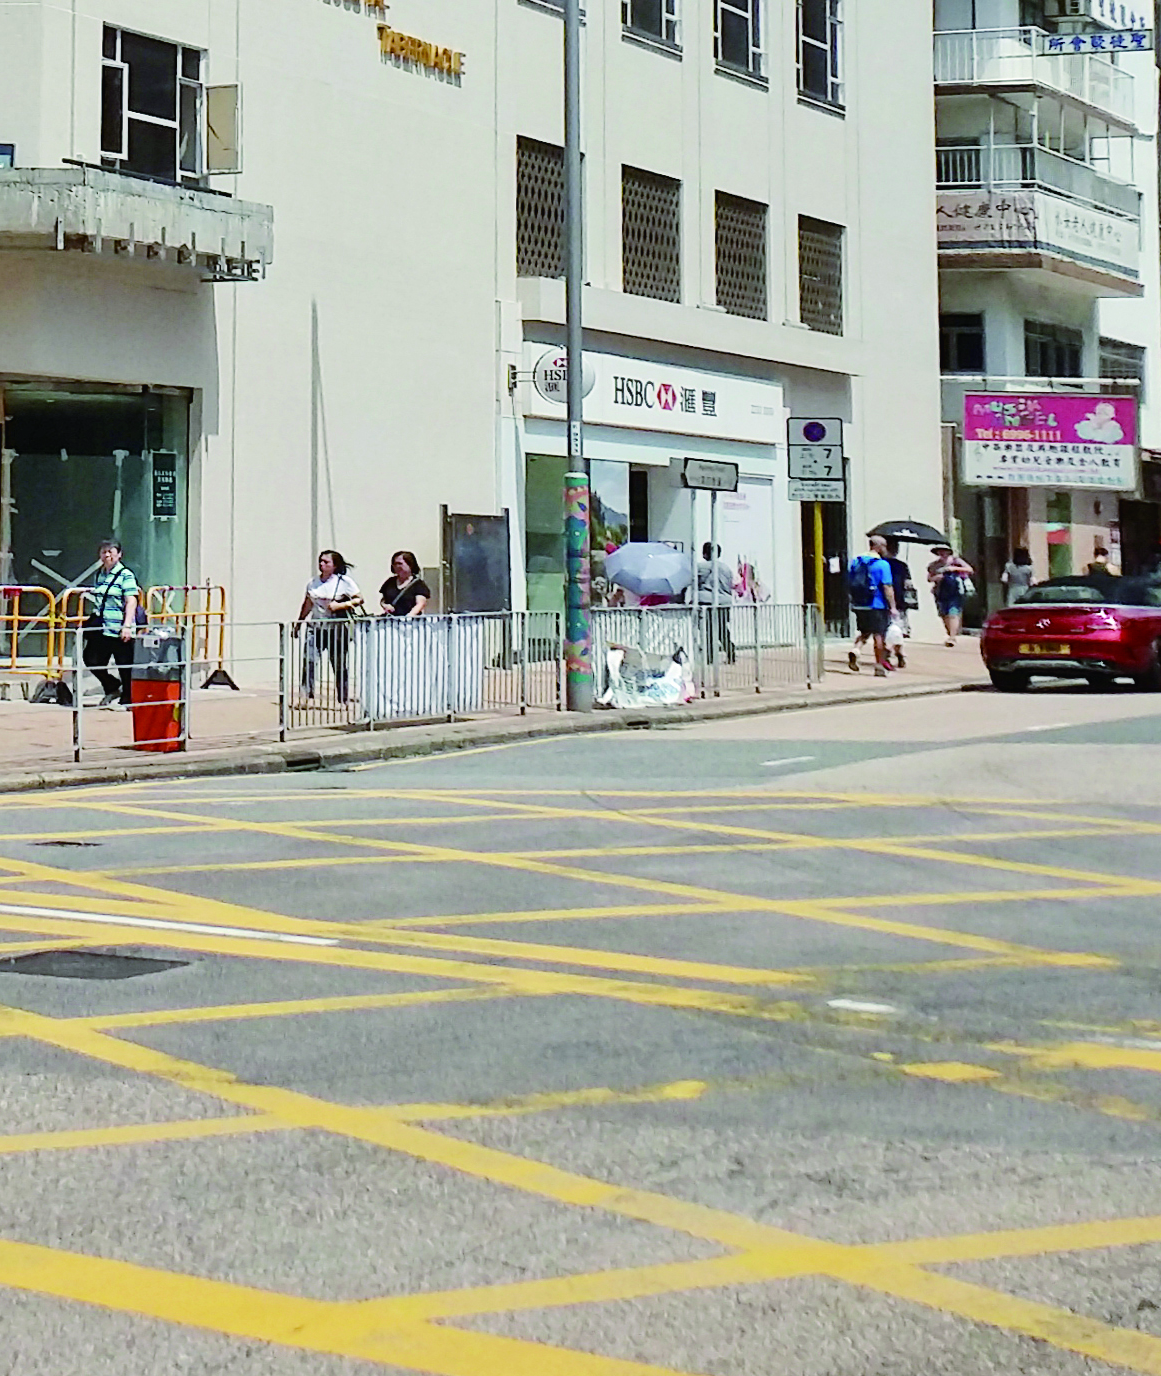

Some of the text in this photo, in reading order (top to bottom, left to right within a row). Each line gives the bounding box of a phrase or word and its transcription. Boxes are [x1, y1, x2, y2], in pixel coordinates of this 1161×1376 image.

[613, 376, 655, 409] HSBC
[822, 447, 833, 459] 7
[823, 465, 833, 476] 7
